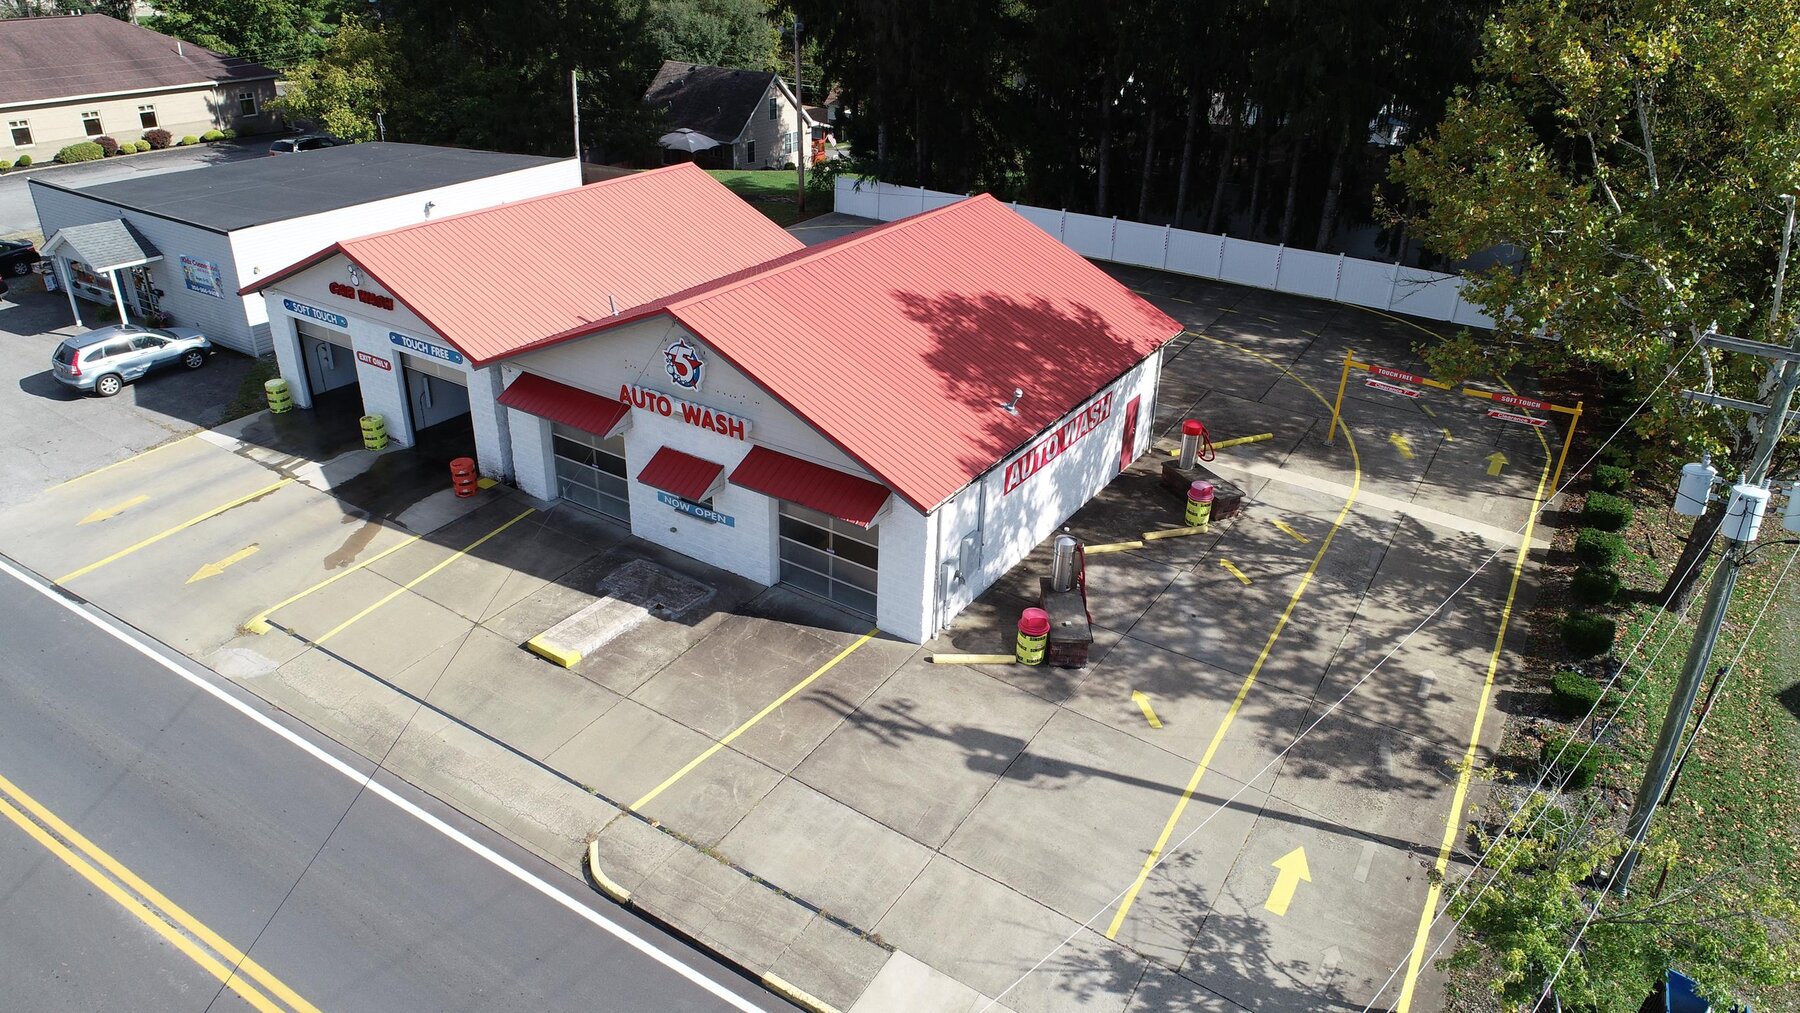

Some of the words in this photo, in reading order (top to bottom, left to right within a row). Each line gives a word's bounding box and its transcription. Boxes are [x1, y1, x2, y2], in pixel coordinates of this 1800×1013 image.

[329, 282, 356, 299] CAR
[358, 290, 394, 311] WASH
[292, 302, 310, 316] SOFT
[311, 308, 338, 324] TOUCH
[401, 336, 429, 354] TOUCH
[430, 346, 450, 359] FREE
[357, 352, 372, 364] EXIT
[372, 358, 389, 370] ONLY
[672, 345, 693, 383] 5
[1378, 368, 1399, 378] TOUCH
[1399, 373, 1414, 382] FREE
[1374, 383, 1403, 394] Clearance
[619, 384, 672, 417] AUTO
[681, 402, 745, 441] WASH
[1501, 395, 1517, 404] SOFT
[1518, 399, 1541, 408] TOUCH
[1497, 413, 1529, 423] Clearance
[1006, 430, 1059, 492] AUTO
[1063, 394, 1112, 447] WASH
[664, 495, 690, 511] NOW
[694, 507, 727, 523] OPEN
